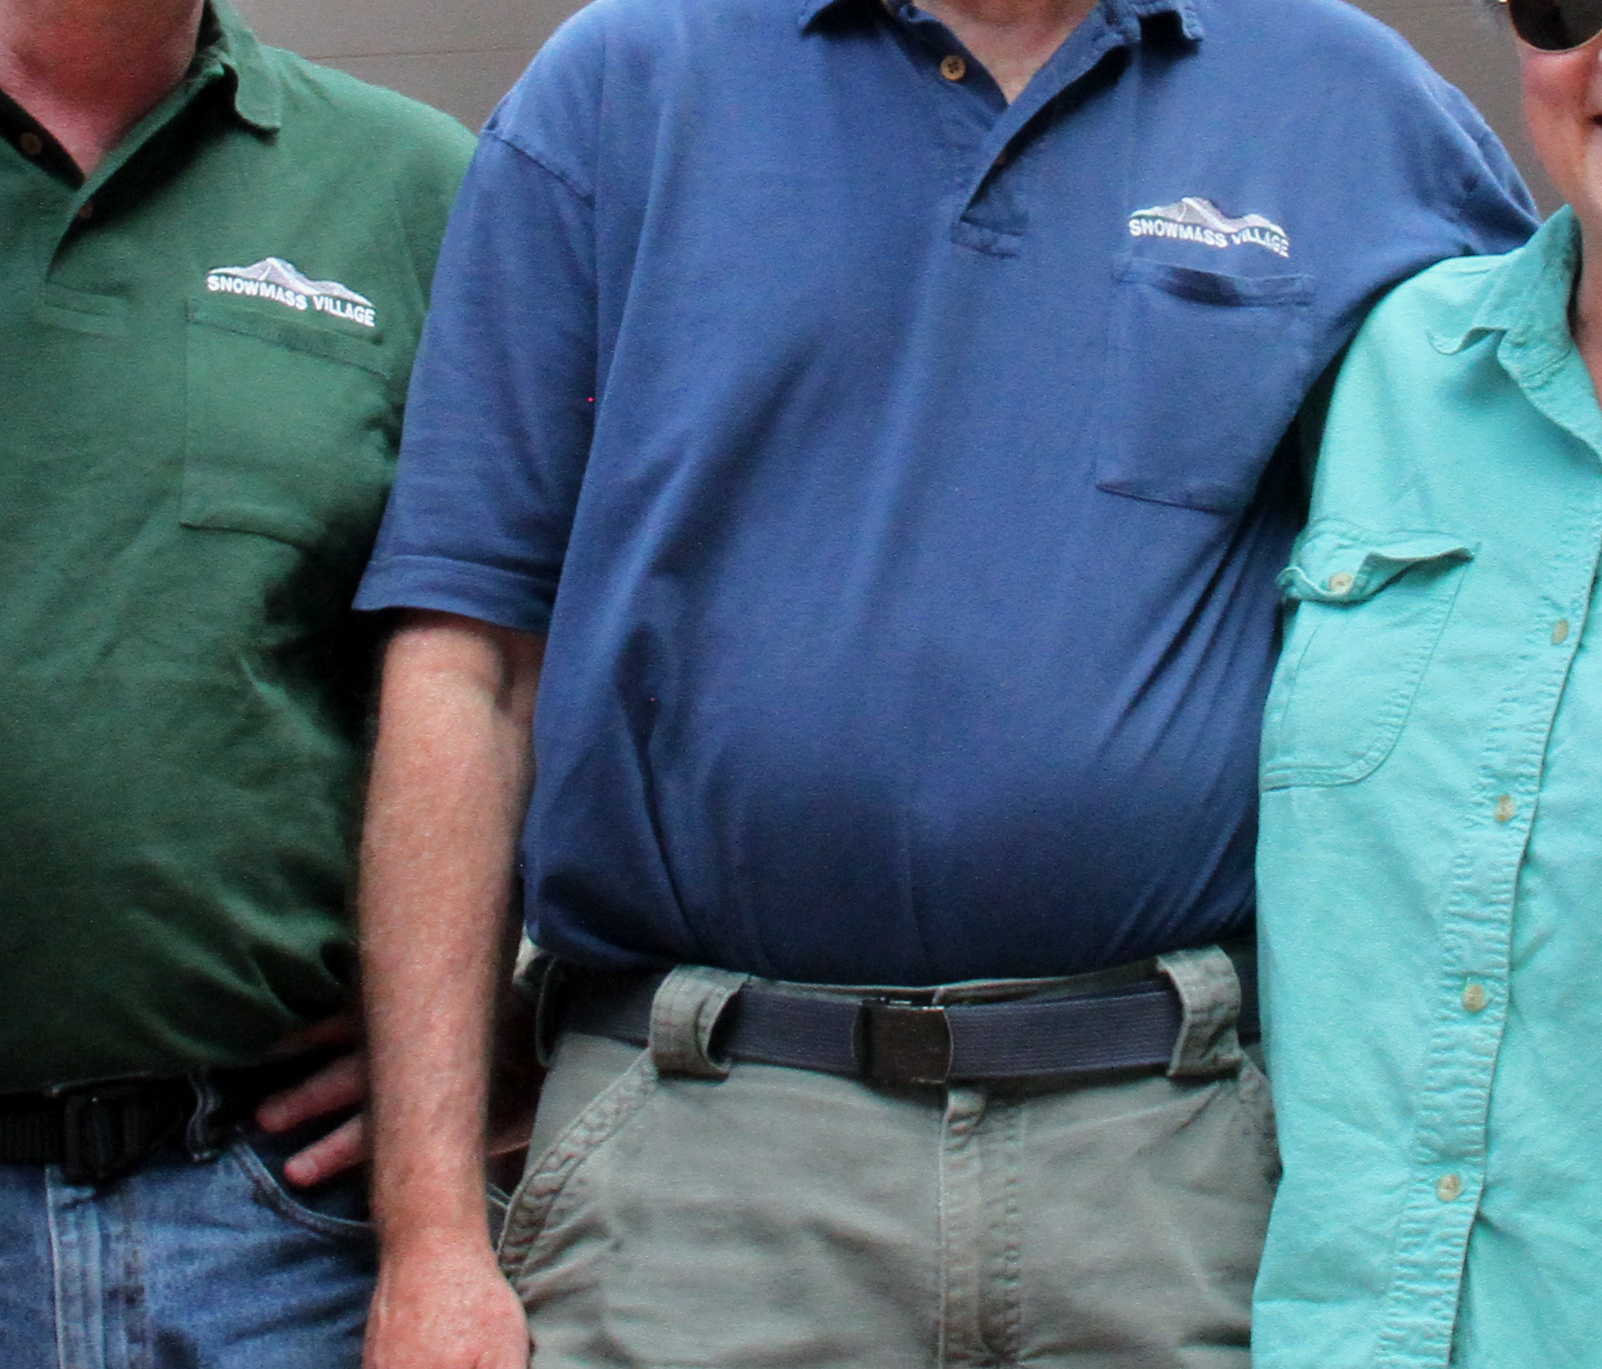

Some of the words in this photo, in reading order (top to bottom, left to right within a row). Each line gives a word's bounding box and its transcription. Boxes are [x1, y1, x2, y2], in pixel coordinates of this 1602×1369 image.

[1128, 218, 1229, 249] SNOWMASS
[1230, 227, 1291, 259] VILLAGE
[206, 274, 309, 311] SNOWMASS
[312, 294, 376, 328] VILLAGE
